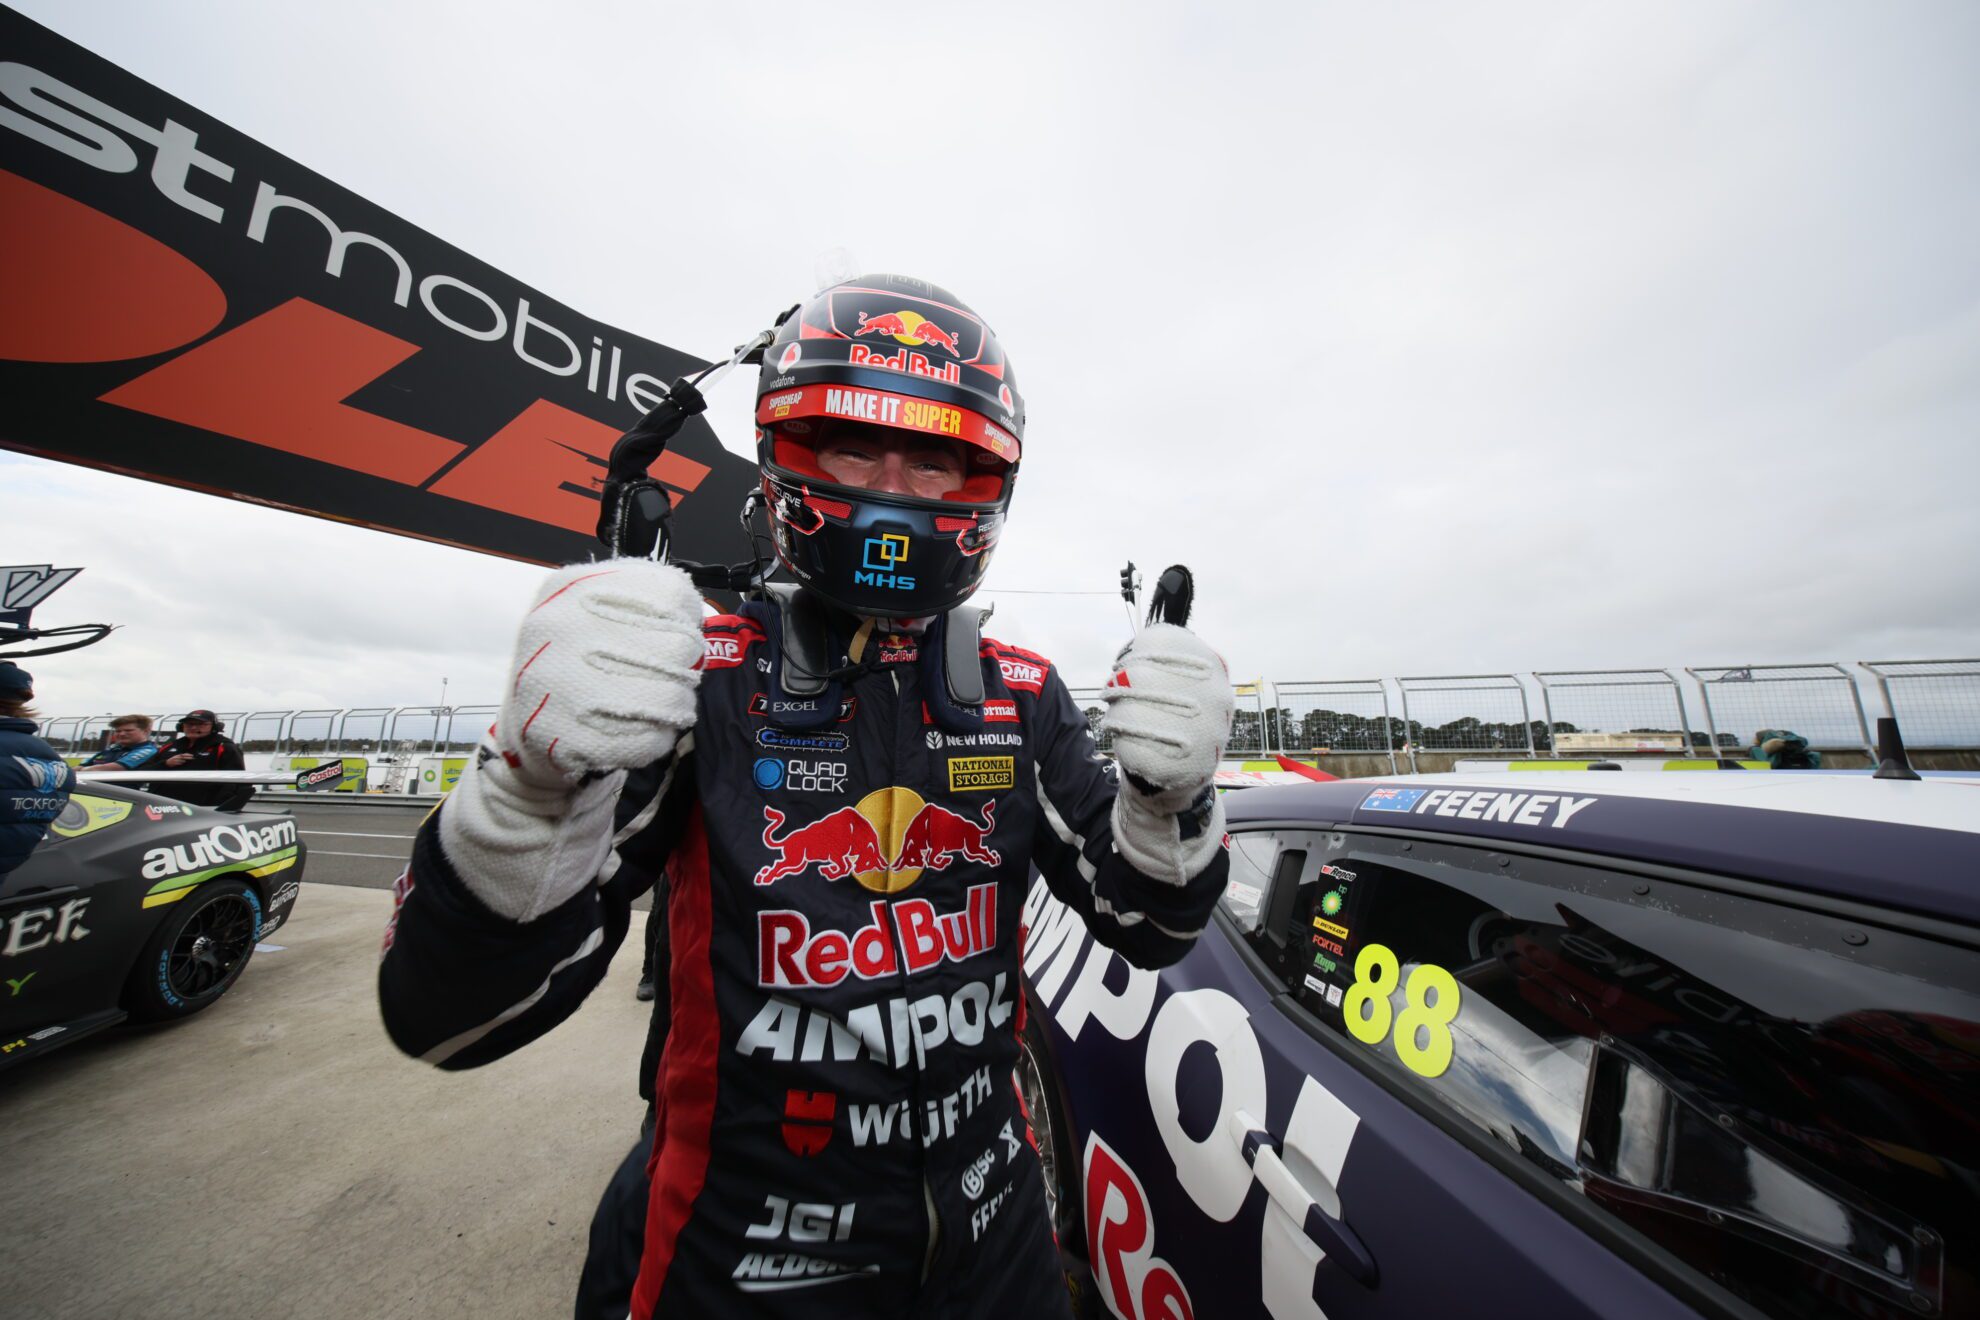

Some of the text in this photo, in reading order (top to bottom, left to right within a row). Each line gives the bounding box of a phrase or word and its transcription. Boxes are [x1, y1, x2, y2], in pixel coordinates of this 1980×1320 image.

[848, 343, 961, 385] Red Bull
[770, 375, 796, 389] vodafone
[769, 391, 803, 410] SUPERCHEAP
[825, 388, 962, 435] MAKE IT SUPER
[769, 481, 802, 508] RECURVE
[854, 570, 916, 590] MHS
[702, 639, 738, 657] MP
[880, 649, 918, 663] Red Bull
[1000, 663, 1042, 681] OMP
[773, 701, 819, 712] EXGEL
[761, 730, 844, 748] COMPLETE
[946, 733, 1022, 746] NEW HOLLAND
[309, 762, 343, 785] Castrol
[788, 760, 847, 776] QUAD
[952, 760, 1012, 771] NATIONAL
[787, 777, 847, 792] LOCK
[956, 773, 1010, 786] STORAGE
[1416, 790, 1598, 830] FEENEY
[1331, 866, 1357, 882] Repco
[1338, 884, 1348, 895] bp
[757, 882, 998, 989] Red Bull
[1320, 922, 1346, 936] DUNLOP
[1312, 934, 1344, 957] FOXTEL
[1342, 943, 1461, 1078] 88
[735, 971, 1013, 1071] AMPOL
[745, 1194, 856, 1242] JGI
